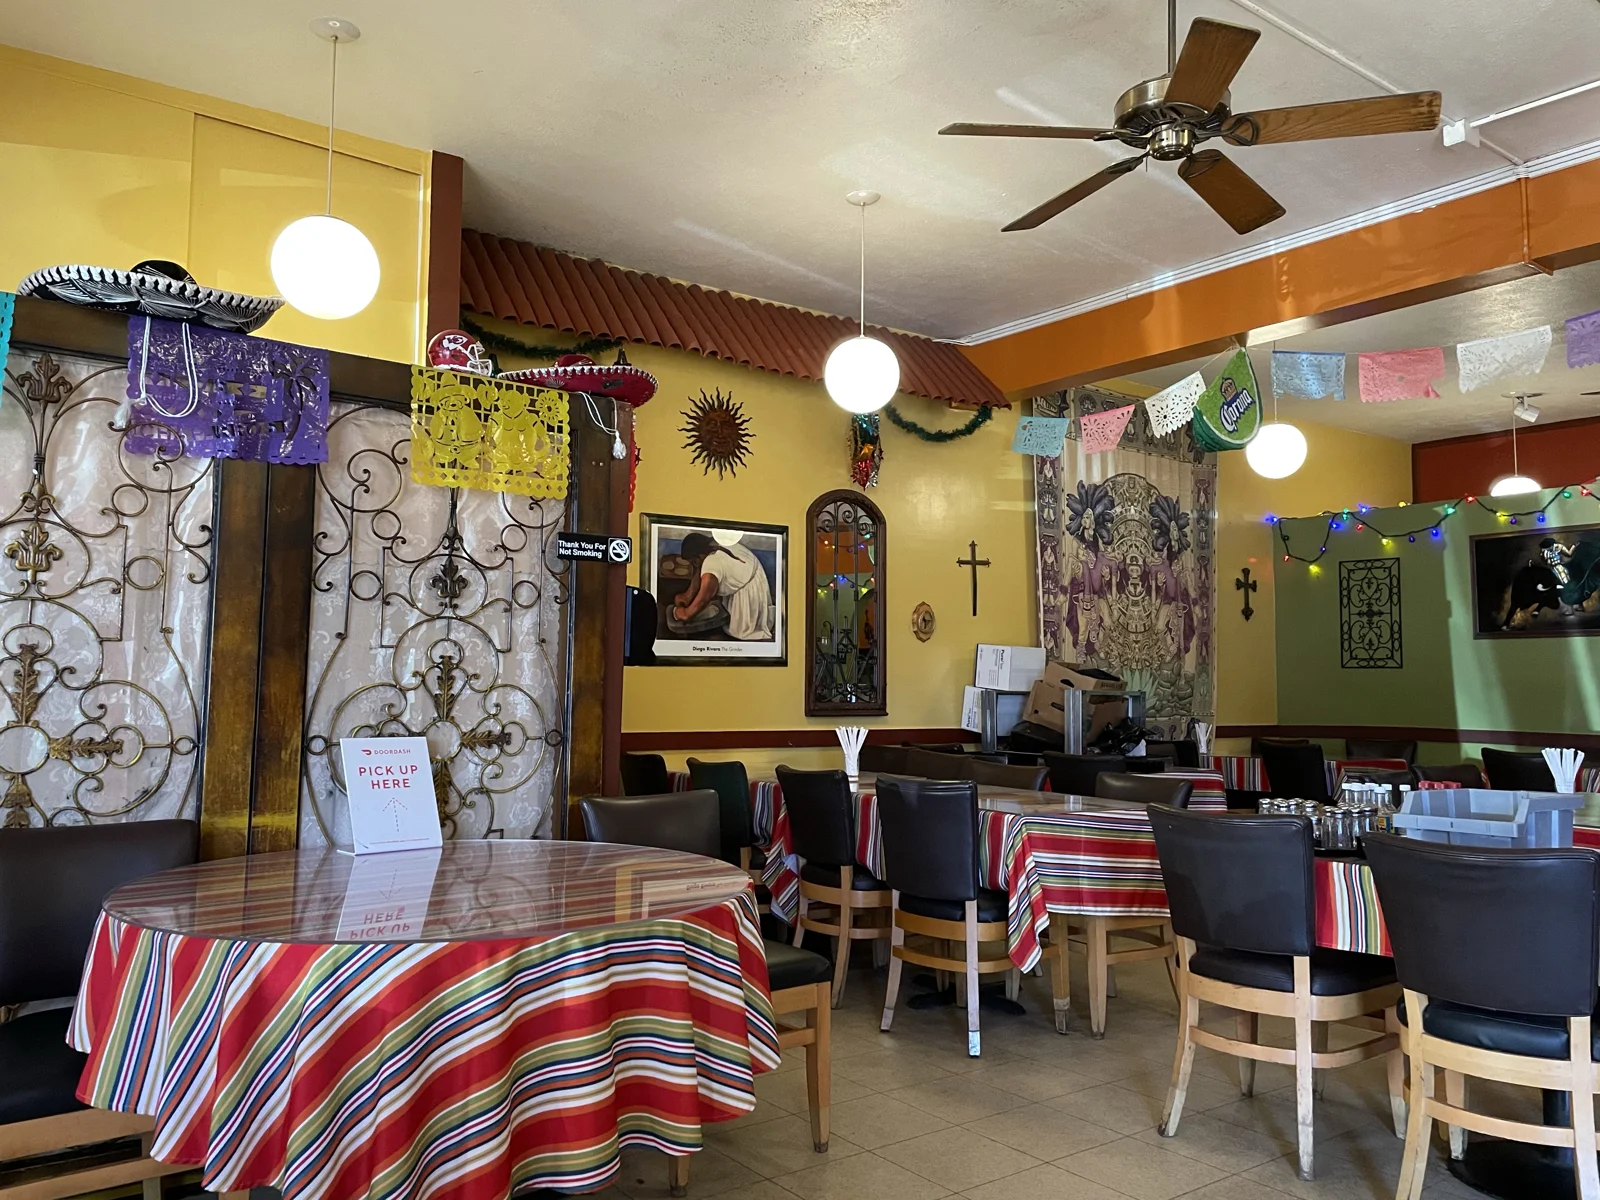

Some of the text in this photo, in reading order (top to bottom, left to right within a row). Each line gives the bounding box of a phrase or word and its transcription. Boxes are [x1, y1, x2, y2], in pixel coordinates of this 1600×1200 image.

[1221, 389, 1253, 431] Corona
[558, 540, 579, 548] Thank
[572, 548, 602, 558] Smoking
[358, 765, 418, 776] PICK UP
[371, 779, 411, 789] HERE
